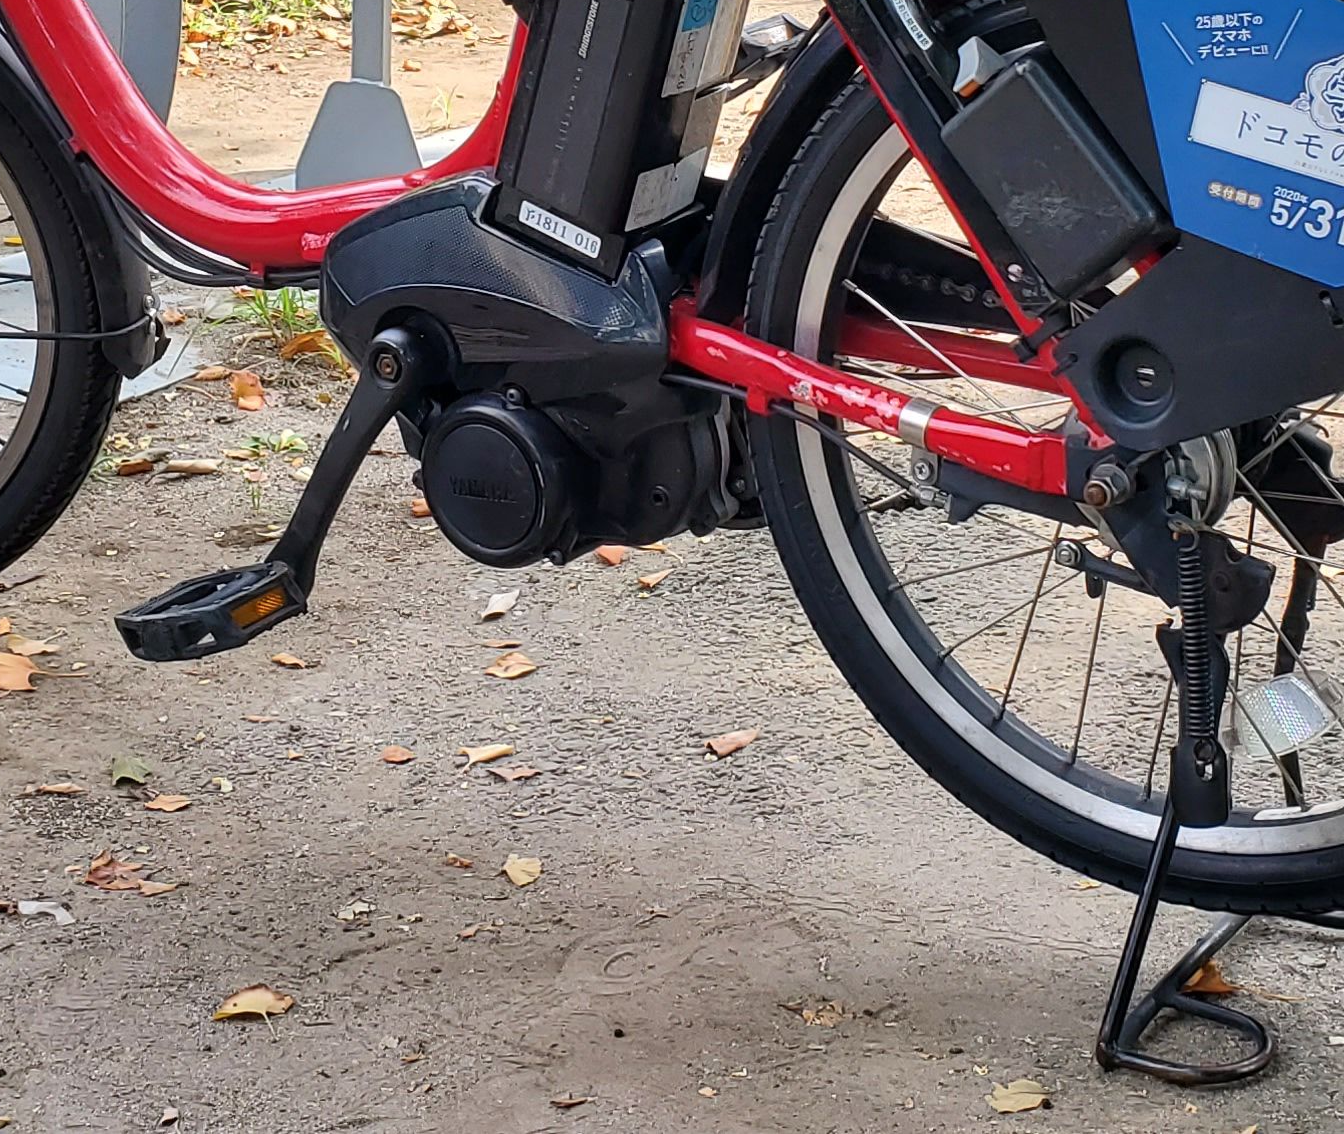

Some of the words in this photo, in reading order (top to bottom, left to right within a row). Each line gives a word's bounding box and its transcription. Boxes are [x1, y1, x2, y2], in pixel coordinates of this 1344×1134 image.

[1195, 13, 1263, 29] 25歳以下の
[1212, 29, 1252, 43] スマホ
[1273, 185, 1309, 204] 2020年
